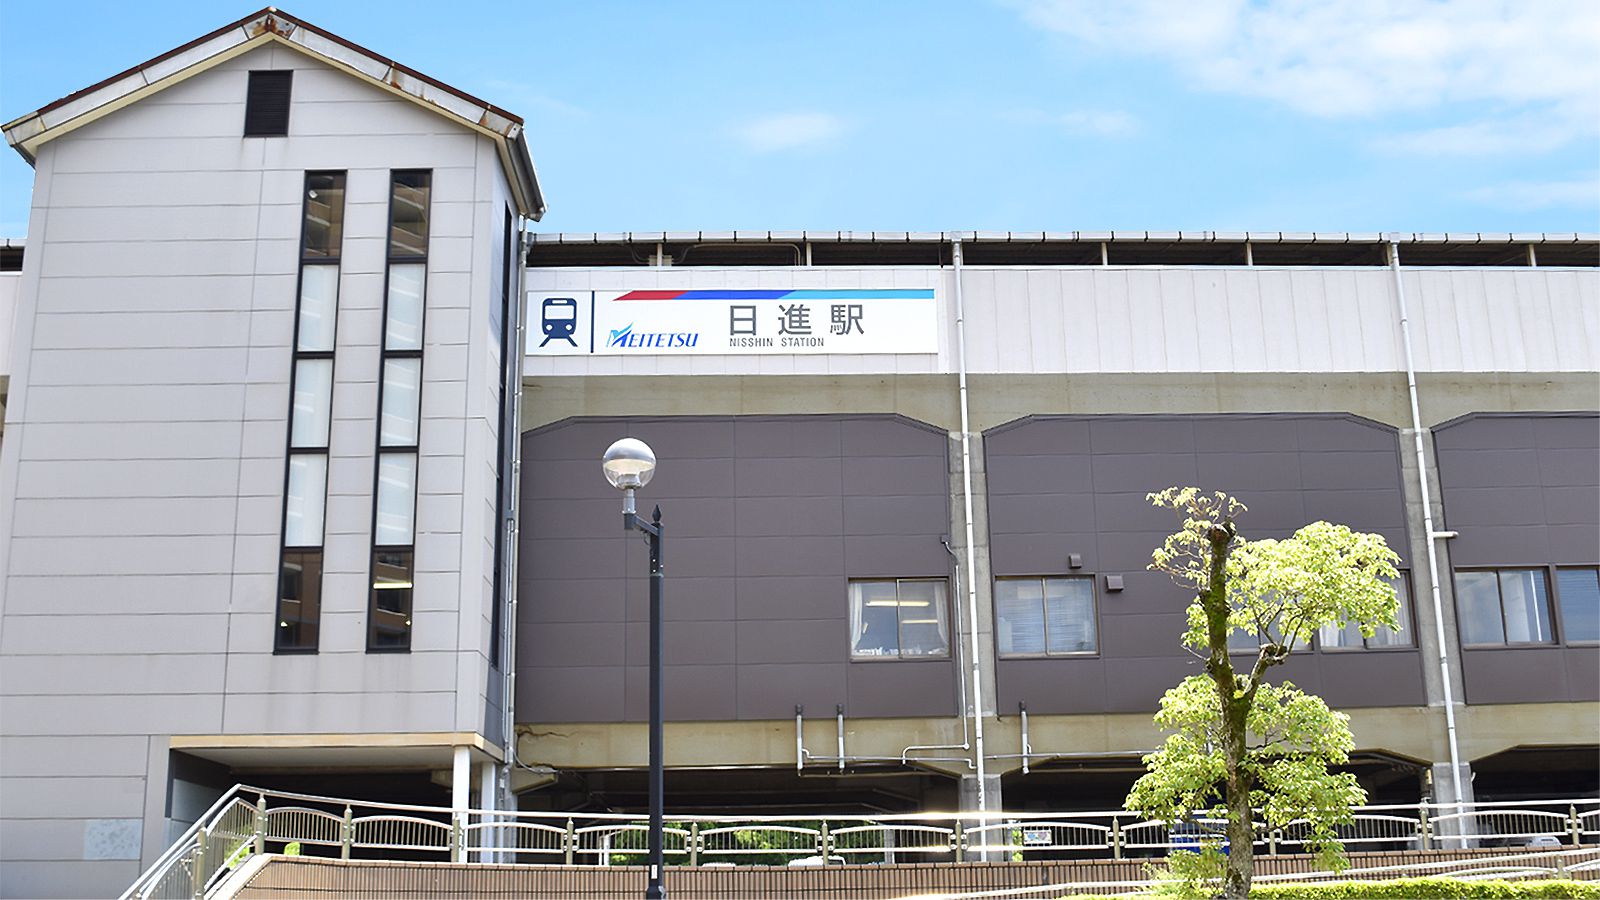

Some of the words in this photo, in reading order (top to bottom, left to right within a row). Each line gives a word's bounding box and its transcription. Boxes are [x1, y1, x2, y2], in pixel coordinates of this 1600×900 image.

[730, 304, 864, 336] 日進駅
[606, 321, 699, 348] MEITETSU
[729, 337, 773, 347] NISSHIN
[781, 337, 824, 347] STATION
